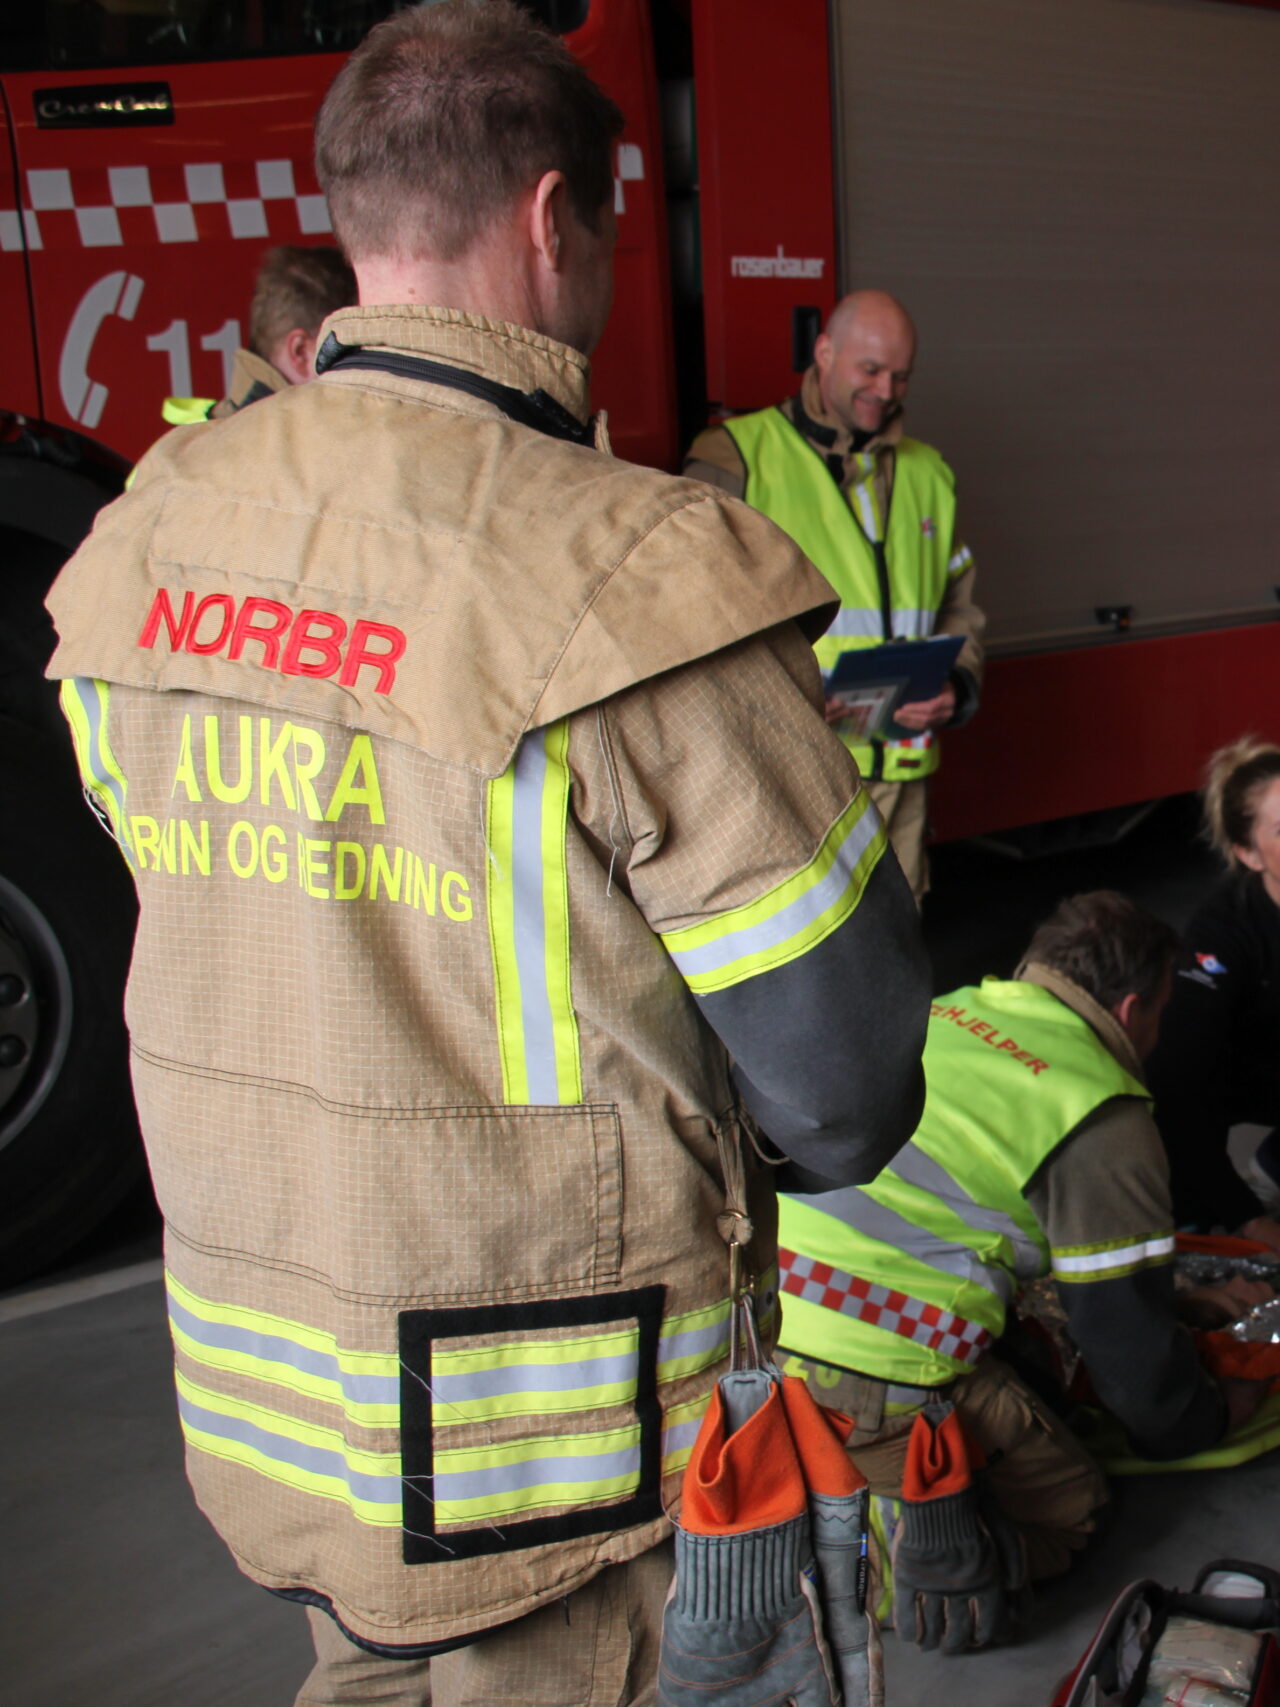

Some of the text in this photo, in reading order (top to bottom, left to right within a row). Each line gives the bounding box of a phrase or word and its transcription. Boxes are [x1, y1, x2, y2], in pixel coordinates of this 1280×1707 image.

[731, 245, 824, 278] rosenbauer
[146, 318, 242, 400] 11
[138, 588, 407, 696] NORBR
[171, 713, 386, 825] AUKRA
[227, 821, 288, 882] OG
[298, 832, 473, 922] REDNING
